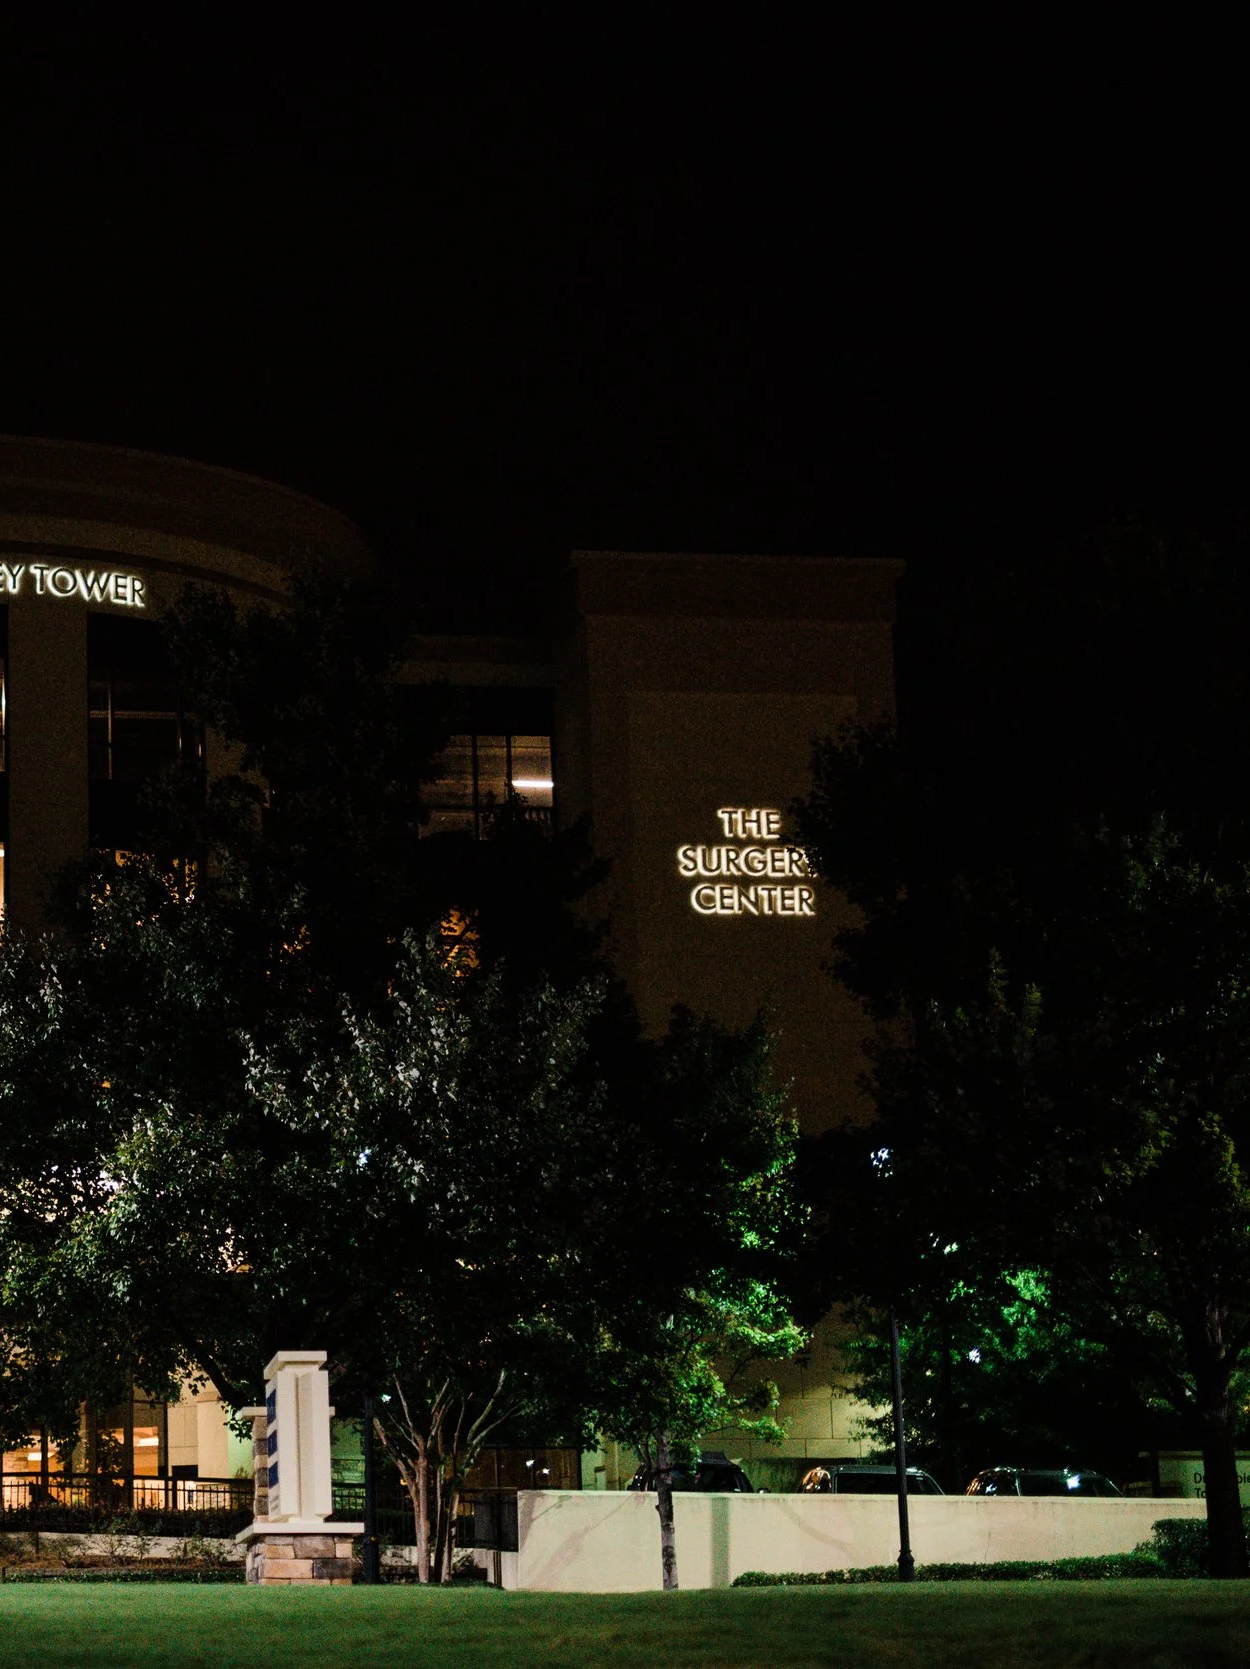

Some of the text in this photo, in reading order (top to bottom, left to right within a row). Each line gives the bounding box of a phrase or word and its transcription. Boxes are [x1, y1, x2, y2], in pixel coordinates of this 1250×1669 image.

[32, 564, 146, 607] TOWER
[718, 808, 781, 838] THE
[678, 845, 817, 876] SURGER
[692, 884, 815, 915] CENTER
